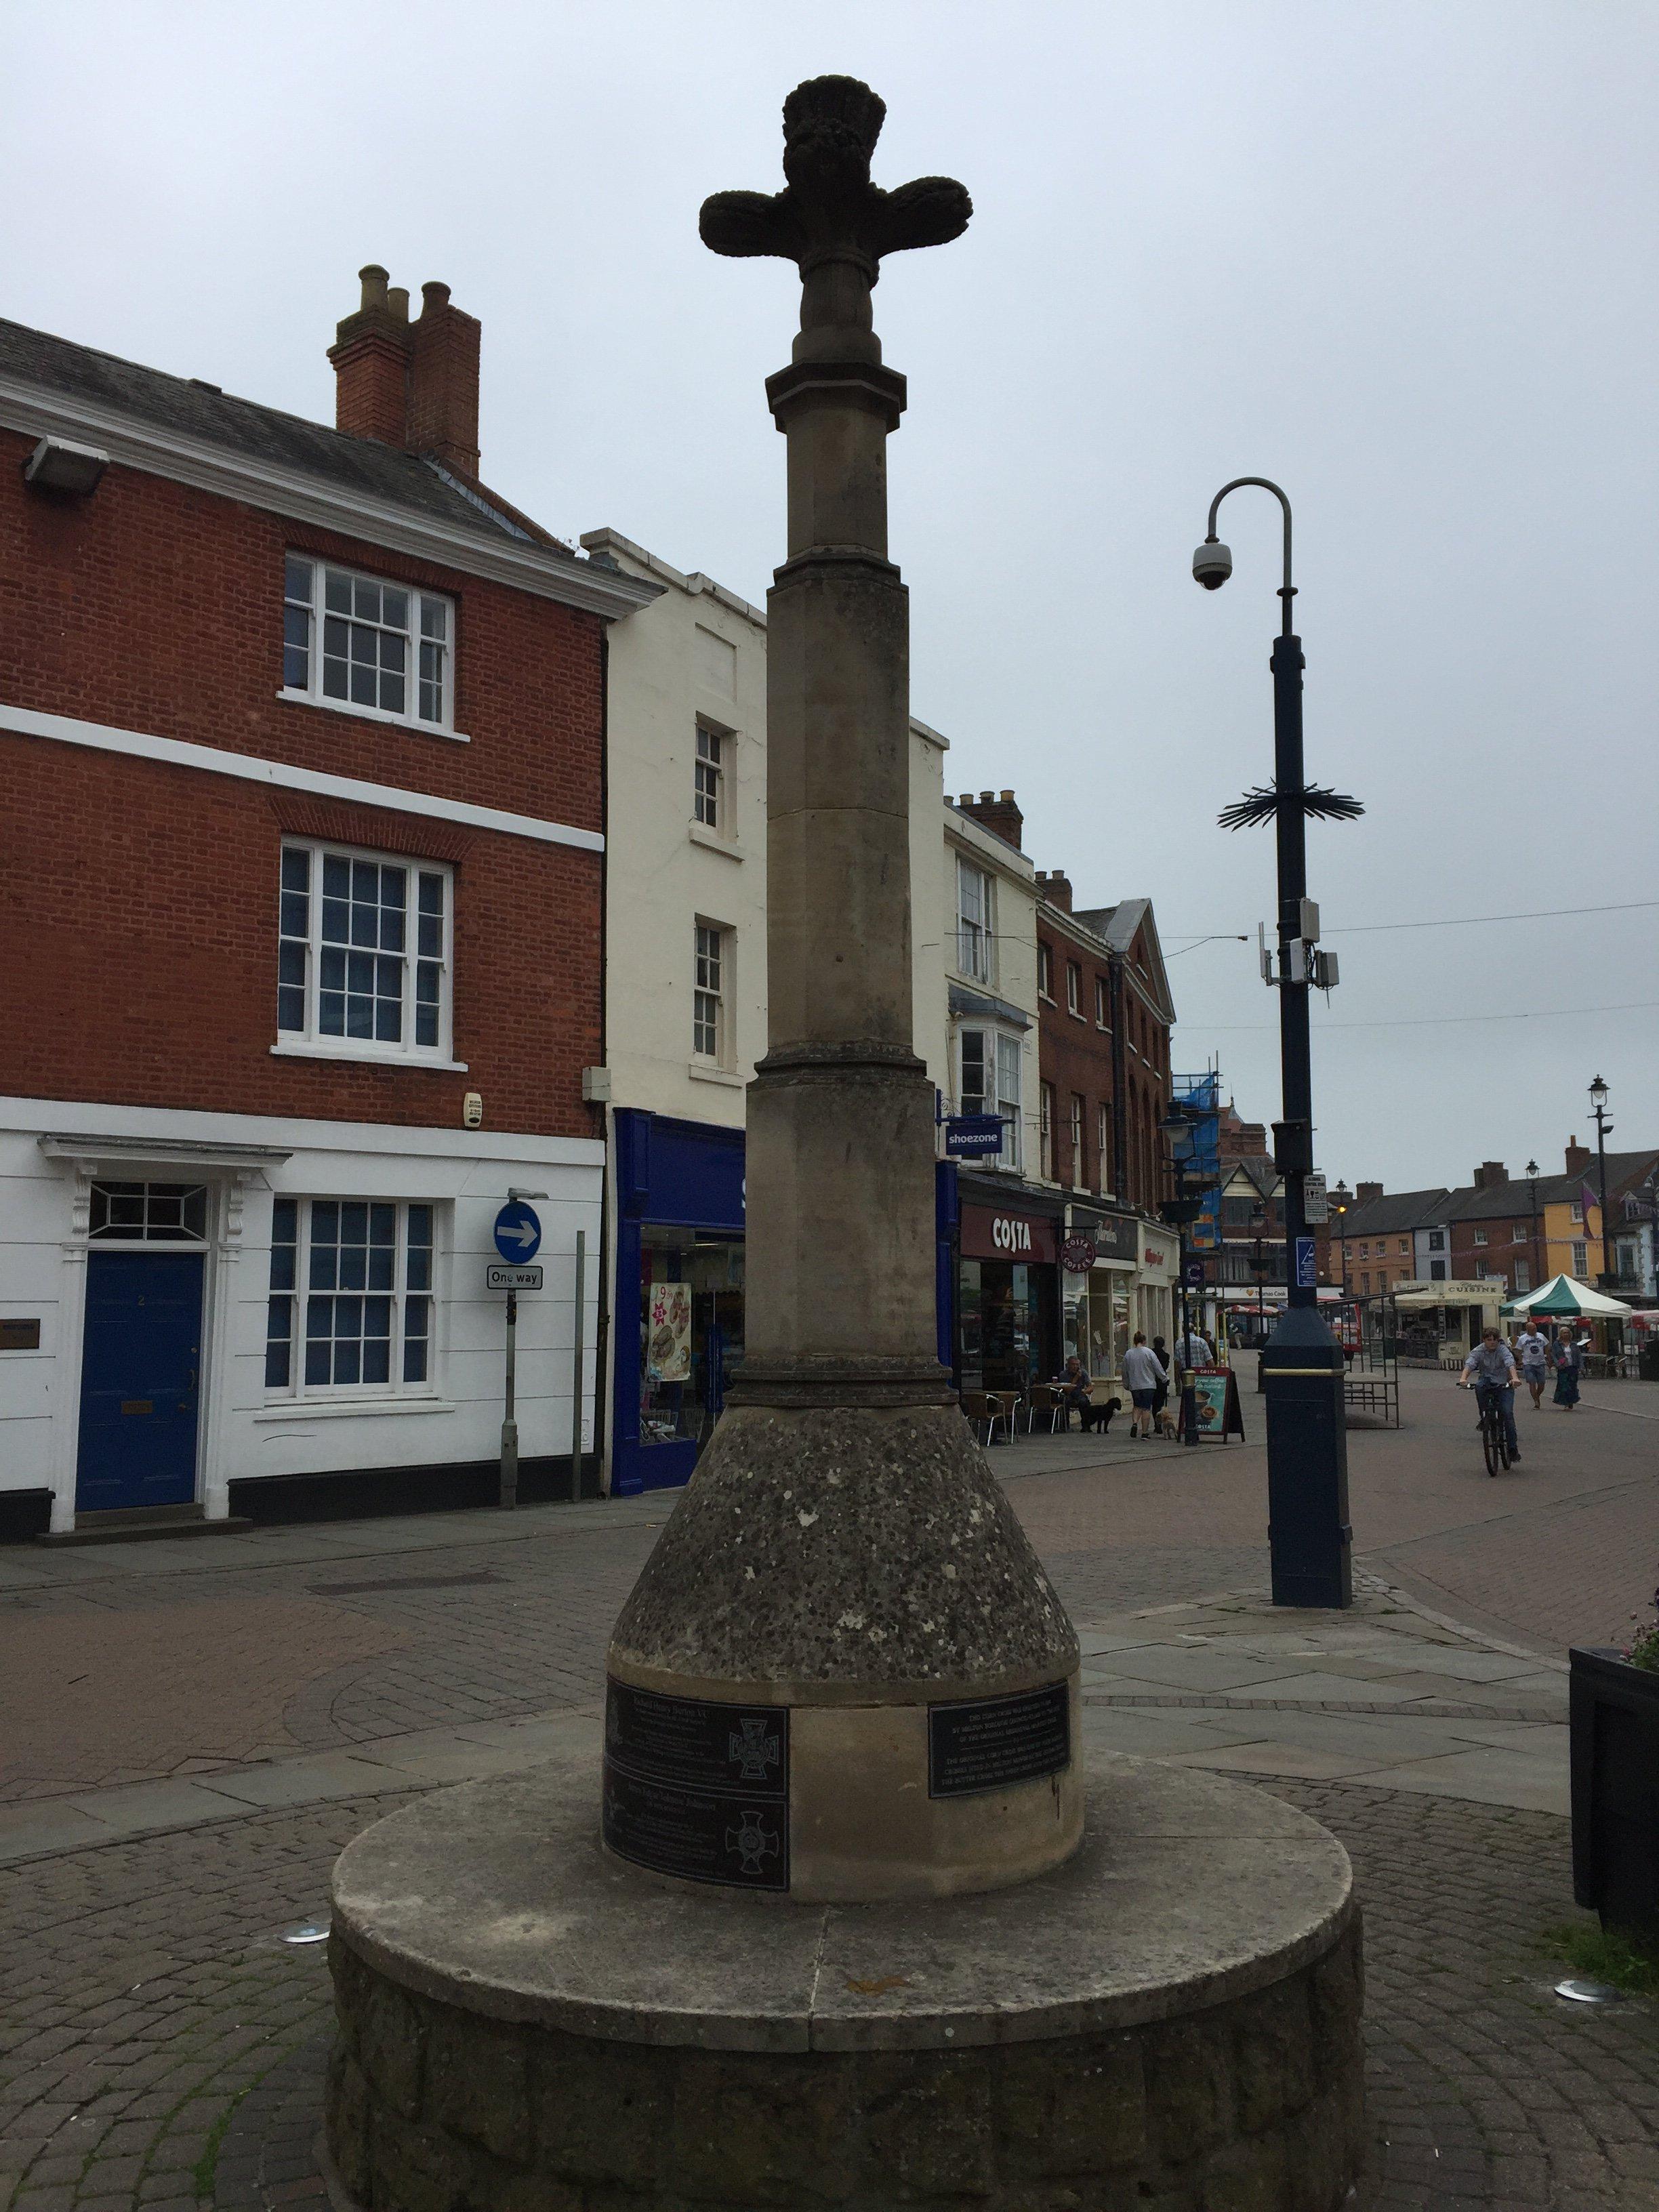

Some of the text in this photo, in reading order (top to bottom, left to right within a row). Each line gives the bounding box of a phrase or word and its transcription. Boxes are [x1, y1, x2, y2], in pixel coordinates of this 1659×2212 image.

[949, 1134, 998, 1144] shoezone
[993, 1217, 1031, 1253] COSTA
[1065, 1239, 1089, 1249] COSTA
[1063, 1258, 1092, 1270] COFFEE
[492, 1271, 537, 1285] One way
